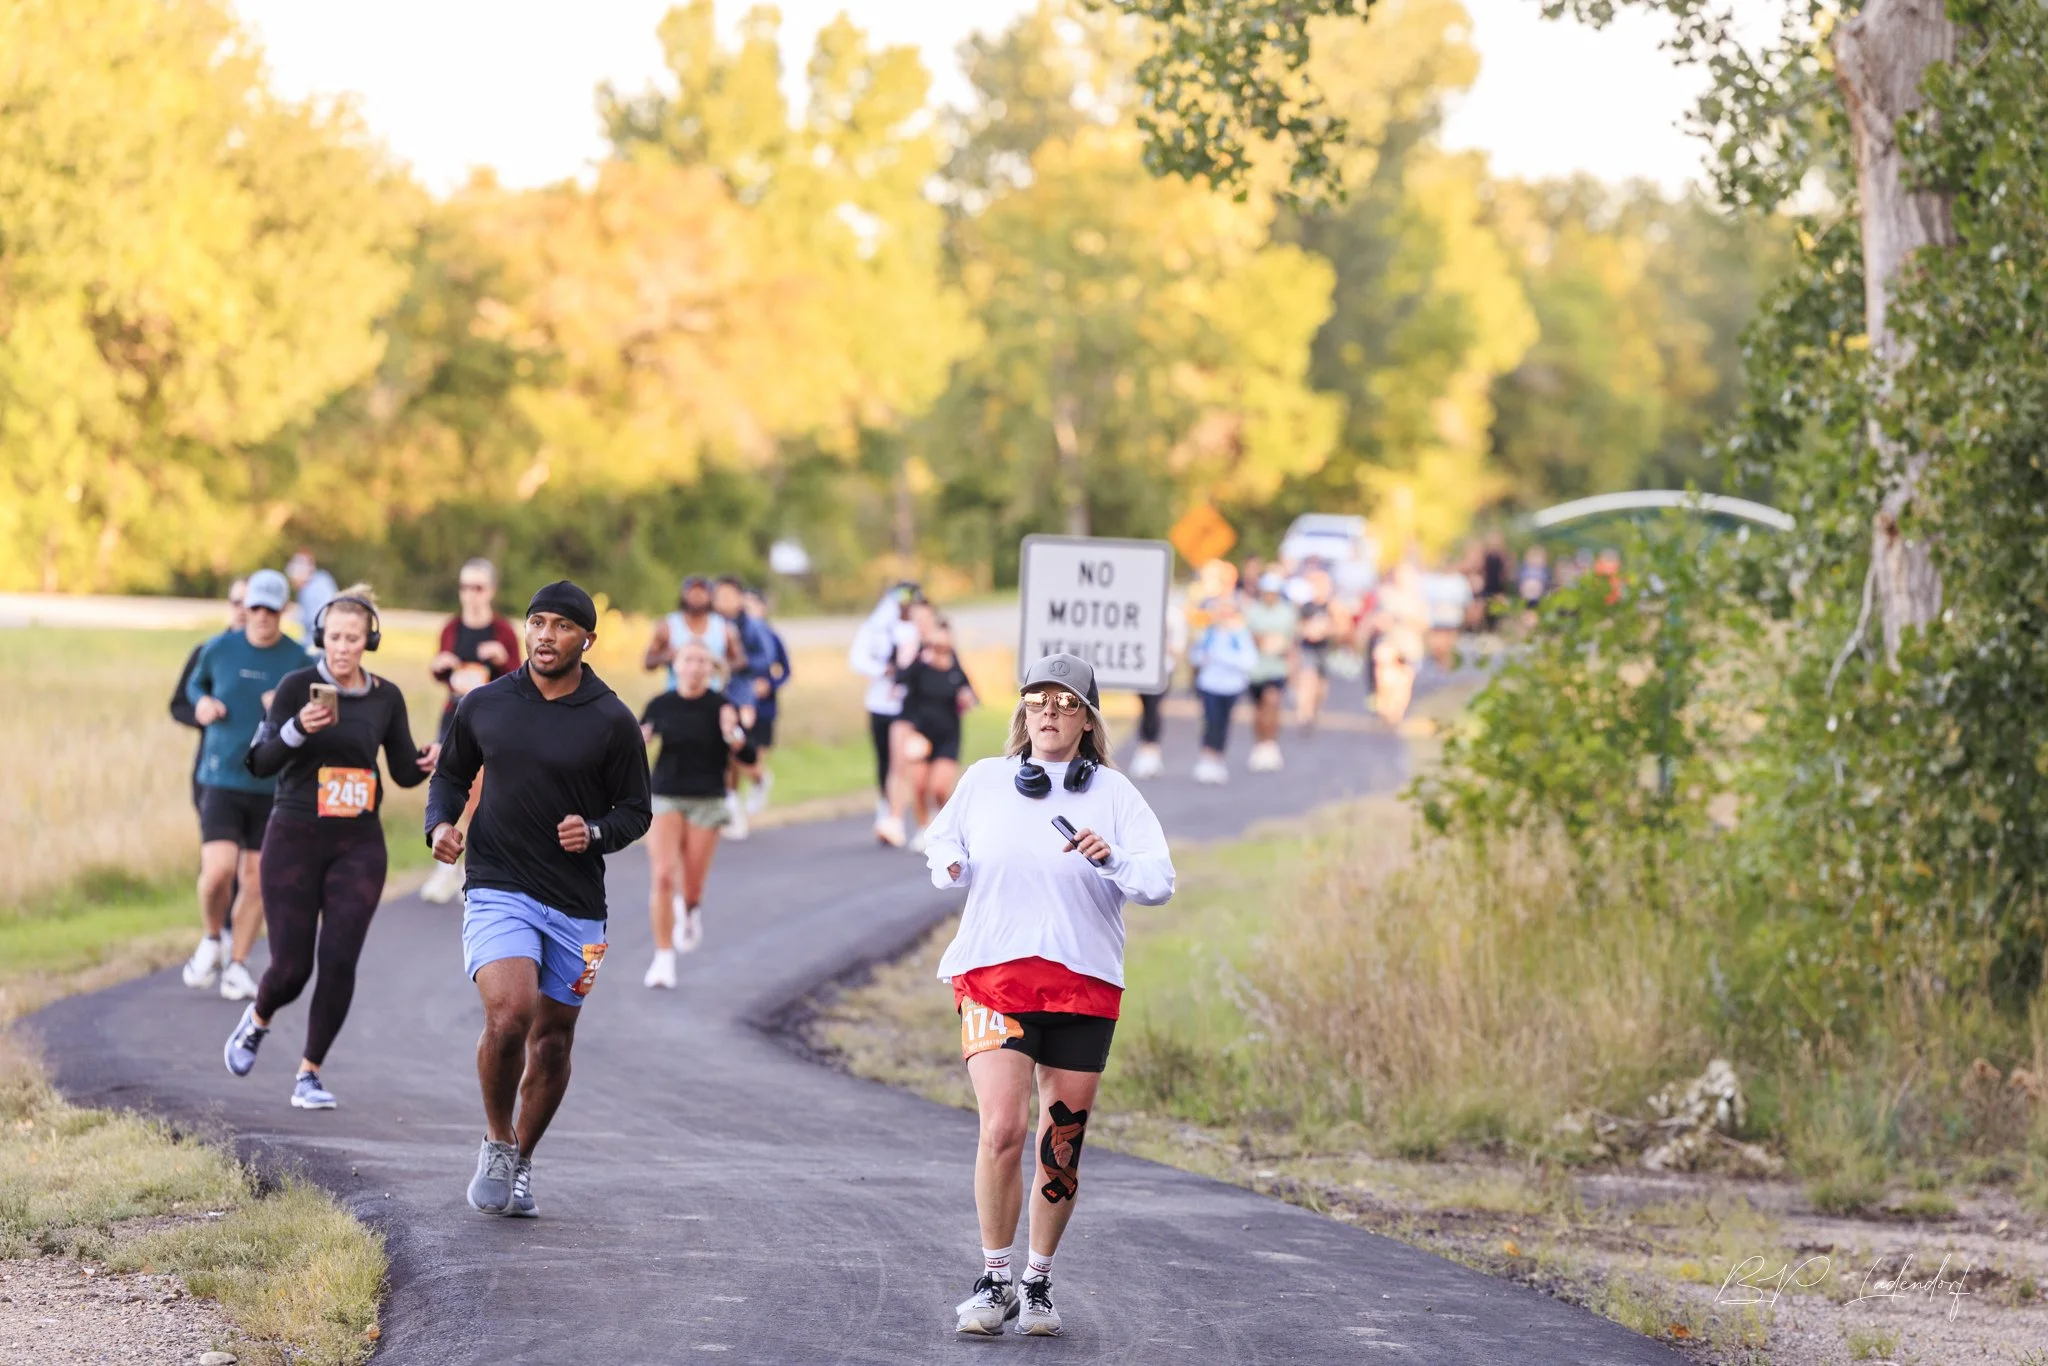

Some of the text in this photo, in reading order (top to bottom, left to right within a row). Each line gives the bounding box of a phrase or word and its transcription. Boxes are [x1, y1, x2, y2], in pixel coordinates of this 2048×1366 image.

[1079, 560, 1115, 588] NO
[1048, 601, 1141, 629] MOTOR
[326, 780, 369, 808] 245
[965, 1007, 1008, 1041] 174
